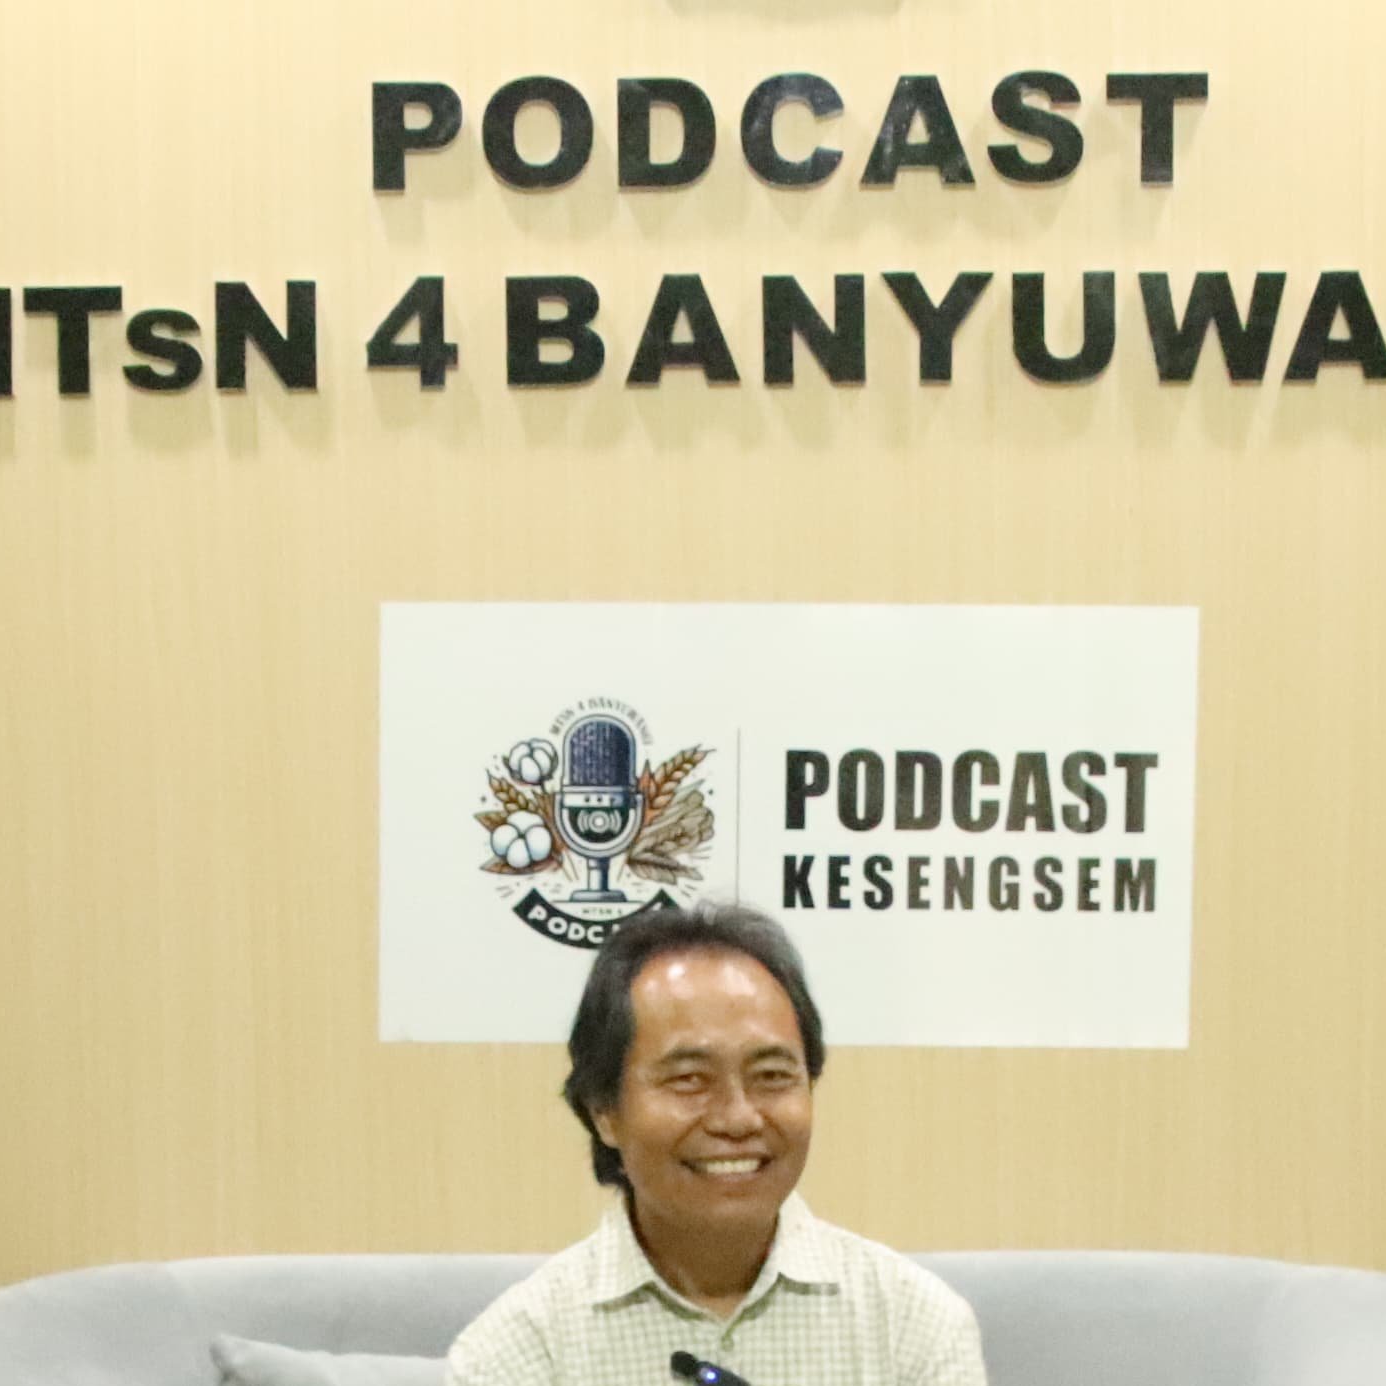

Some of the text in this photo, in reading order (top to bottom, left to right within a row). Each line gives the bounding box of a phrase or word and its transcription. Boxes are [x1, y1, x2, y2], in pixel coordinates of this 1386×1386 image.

[372, 71, 1208, 191] PODCAST
[367, 277, 458, 387] 4
[785, 749, 1159, 834] PODCAST
[783, 855, 1157, 914] KESENGSEM
